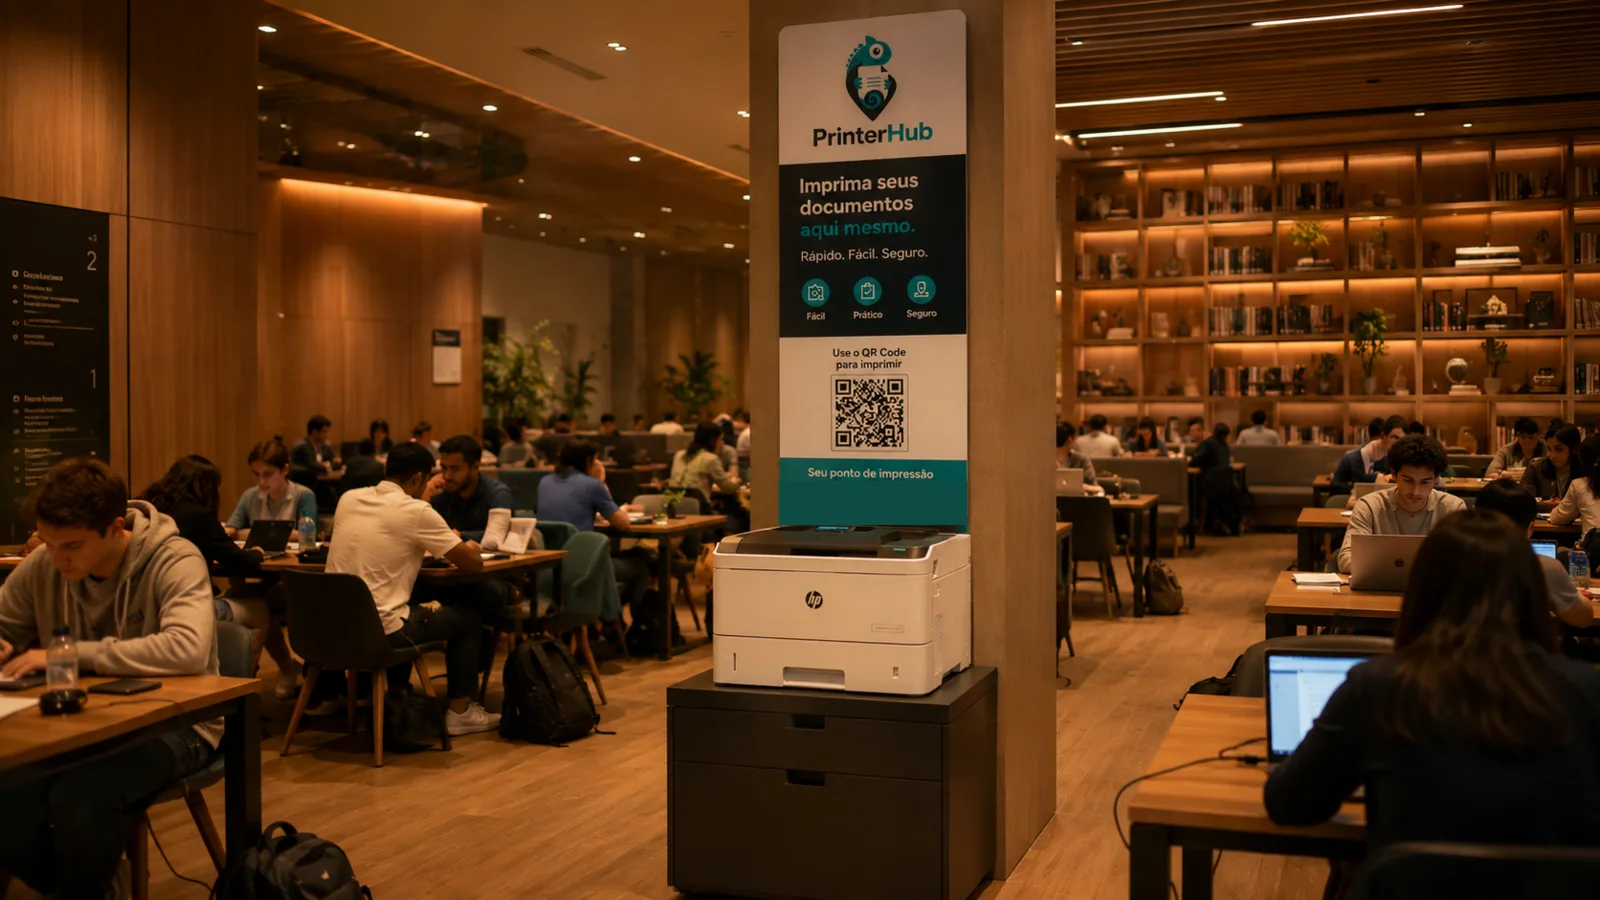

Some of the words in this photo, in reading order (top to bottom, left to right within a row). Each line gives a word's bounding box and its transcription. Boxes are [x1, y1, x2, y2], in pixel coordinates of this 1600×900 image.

[812, 121, 934, 147] PrinterHub
[800, 176, 872, 196] Imprima
[877, 175, 919, 190] seus
[800, 197, 914, 216] documentos
[800, 220, 839, 240] aqui
[844, 220, 916, 236] mesmo.
[86, 250, 97, 271] 2
[800, 250, 845, 264] Rápido.
[848, 248, 878, 261] Fácil.
[881, 247, 928, 262] Seguro.
[806, 311, 826, 321] Fácil
[853, 310, 883, 320] Prático
[906, 309, 937, 320] Seguro
[833, 348, 851, 357] Use
[854, 350, 860, 358] o
[861, 348, 877, 358] QR
[880, 348, 906, 358] Code
[836, 361, 858, 371] para
[860, 359, 902, 370] imprimir
[90, 368, 97, 389] 1
[808, 467, 828, 478] Seu
[830, 468, 862, 480] ponto
[863, 468, 877, 478] de
[879, 469, 934, 480] impressão
[806, 591, 822, 609] hp
